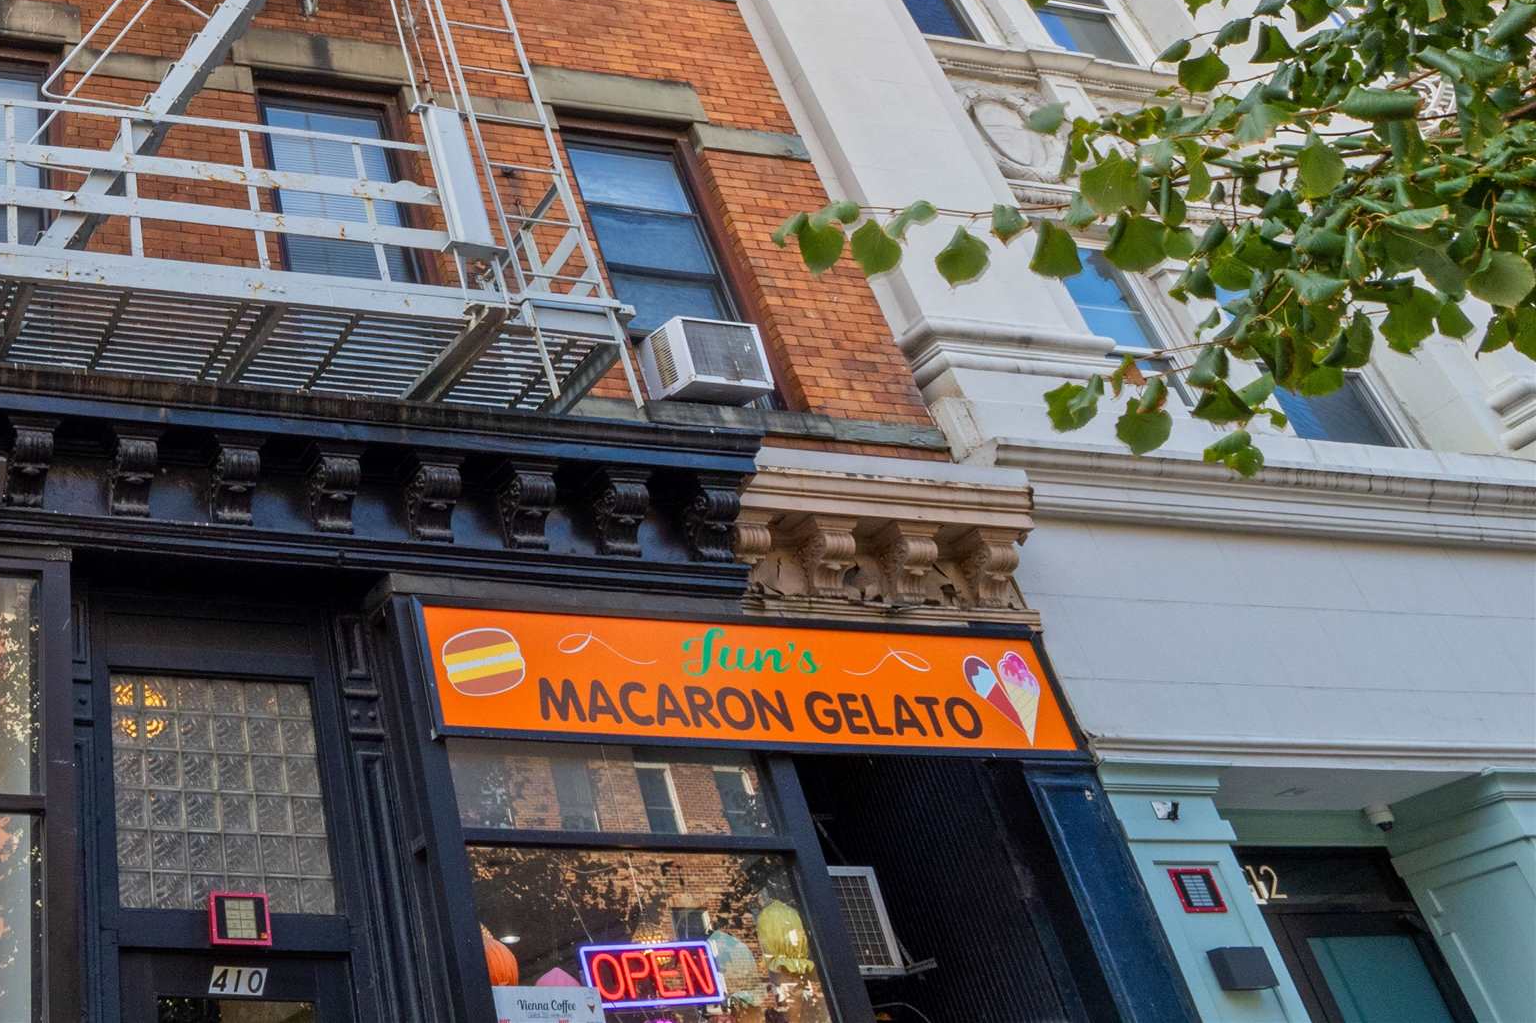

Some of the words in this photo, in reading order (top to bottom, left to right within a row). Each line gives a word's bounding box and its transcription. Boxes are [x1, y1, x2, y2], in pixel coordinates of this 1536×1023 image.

[538, 677, 795, 733] MACARON
[804, 691, 983, 739] GELATO
[212, 968, 263, 993] 410
[592, 948, 716, 1000] OPEN
[517, 999, 549, 1011] Vienna
[551, 999, 576, 1014] Coffee
